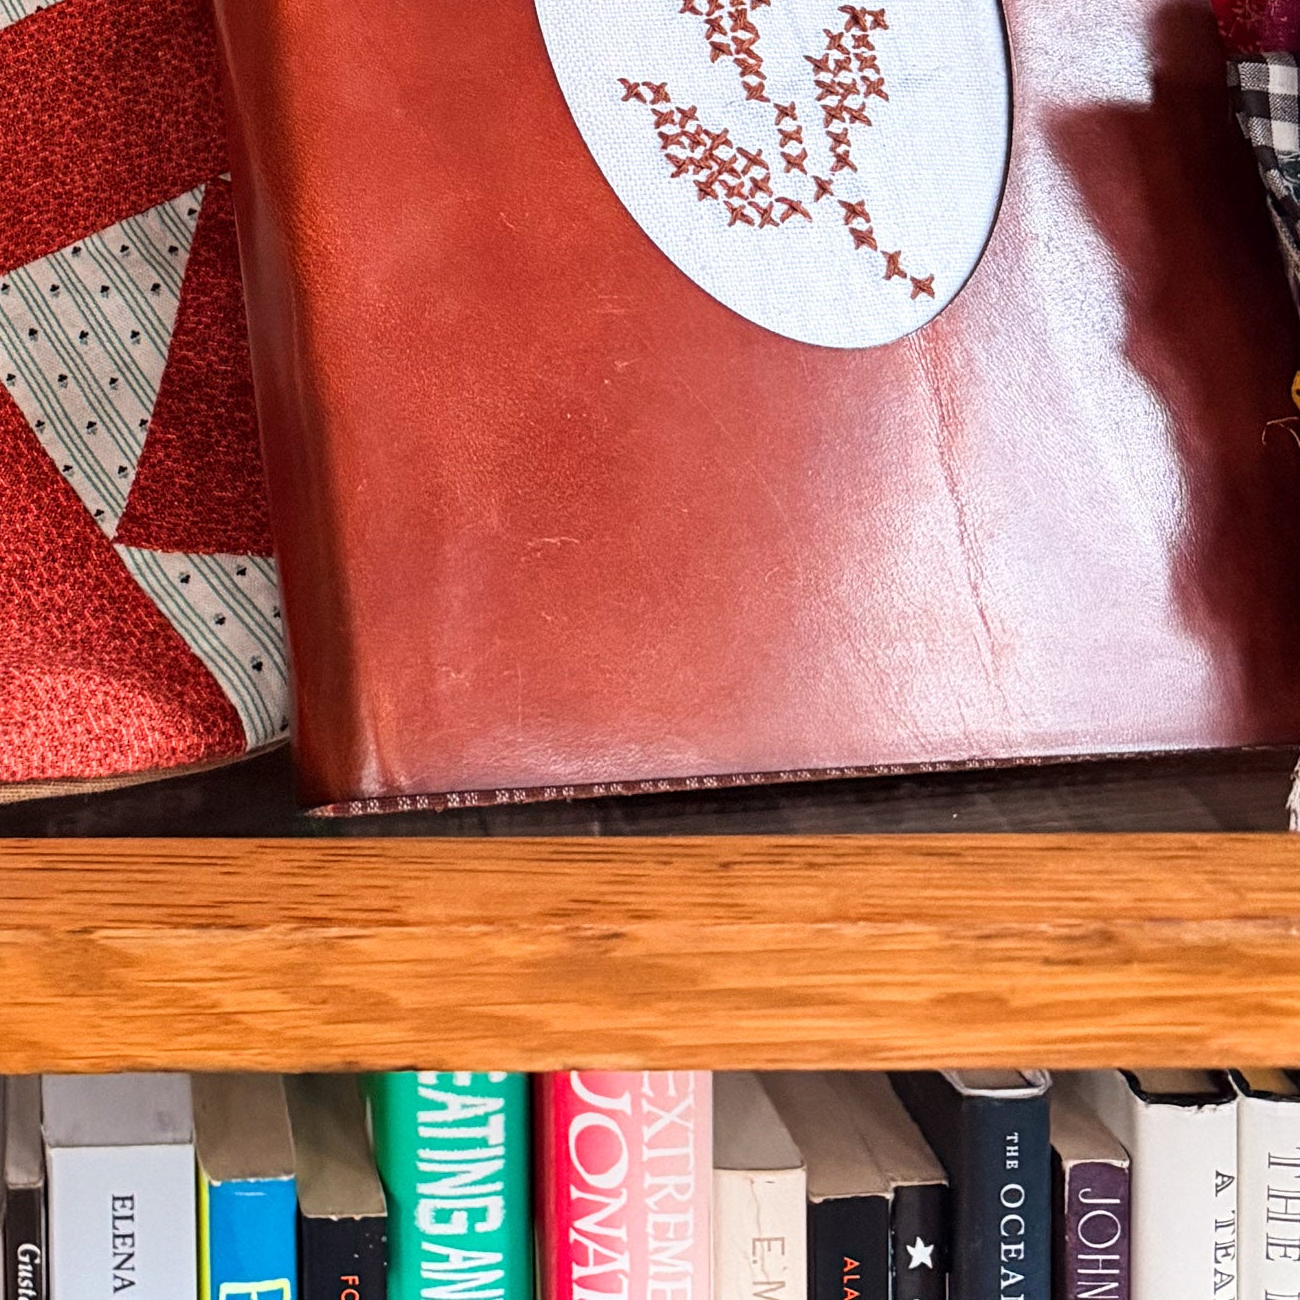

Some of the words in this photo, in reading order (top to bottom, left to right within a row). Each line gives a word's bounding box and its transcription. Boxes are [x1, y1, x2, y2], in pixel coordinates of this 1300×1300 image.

[1006, 1132, 1019, 1169] THE
[1215, 1170, 1235, 1198] A
[112, 1194, 136, 1294] ELENA
[1077, 1188, 1121, 1300] JOHN
